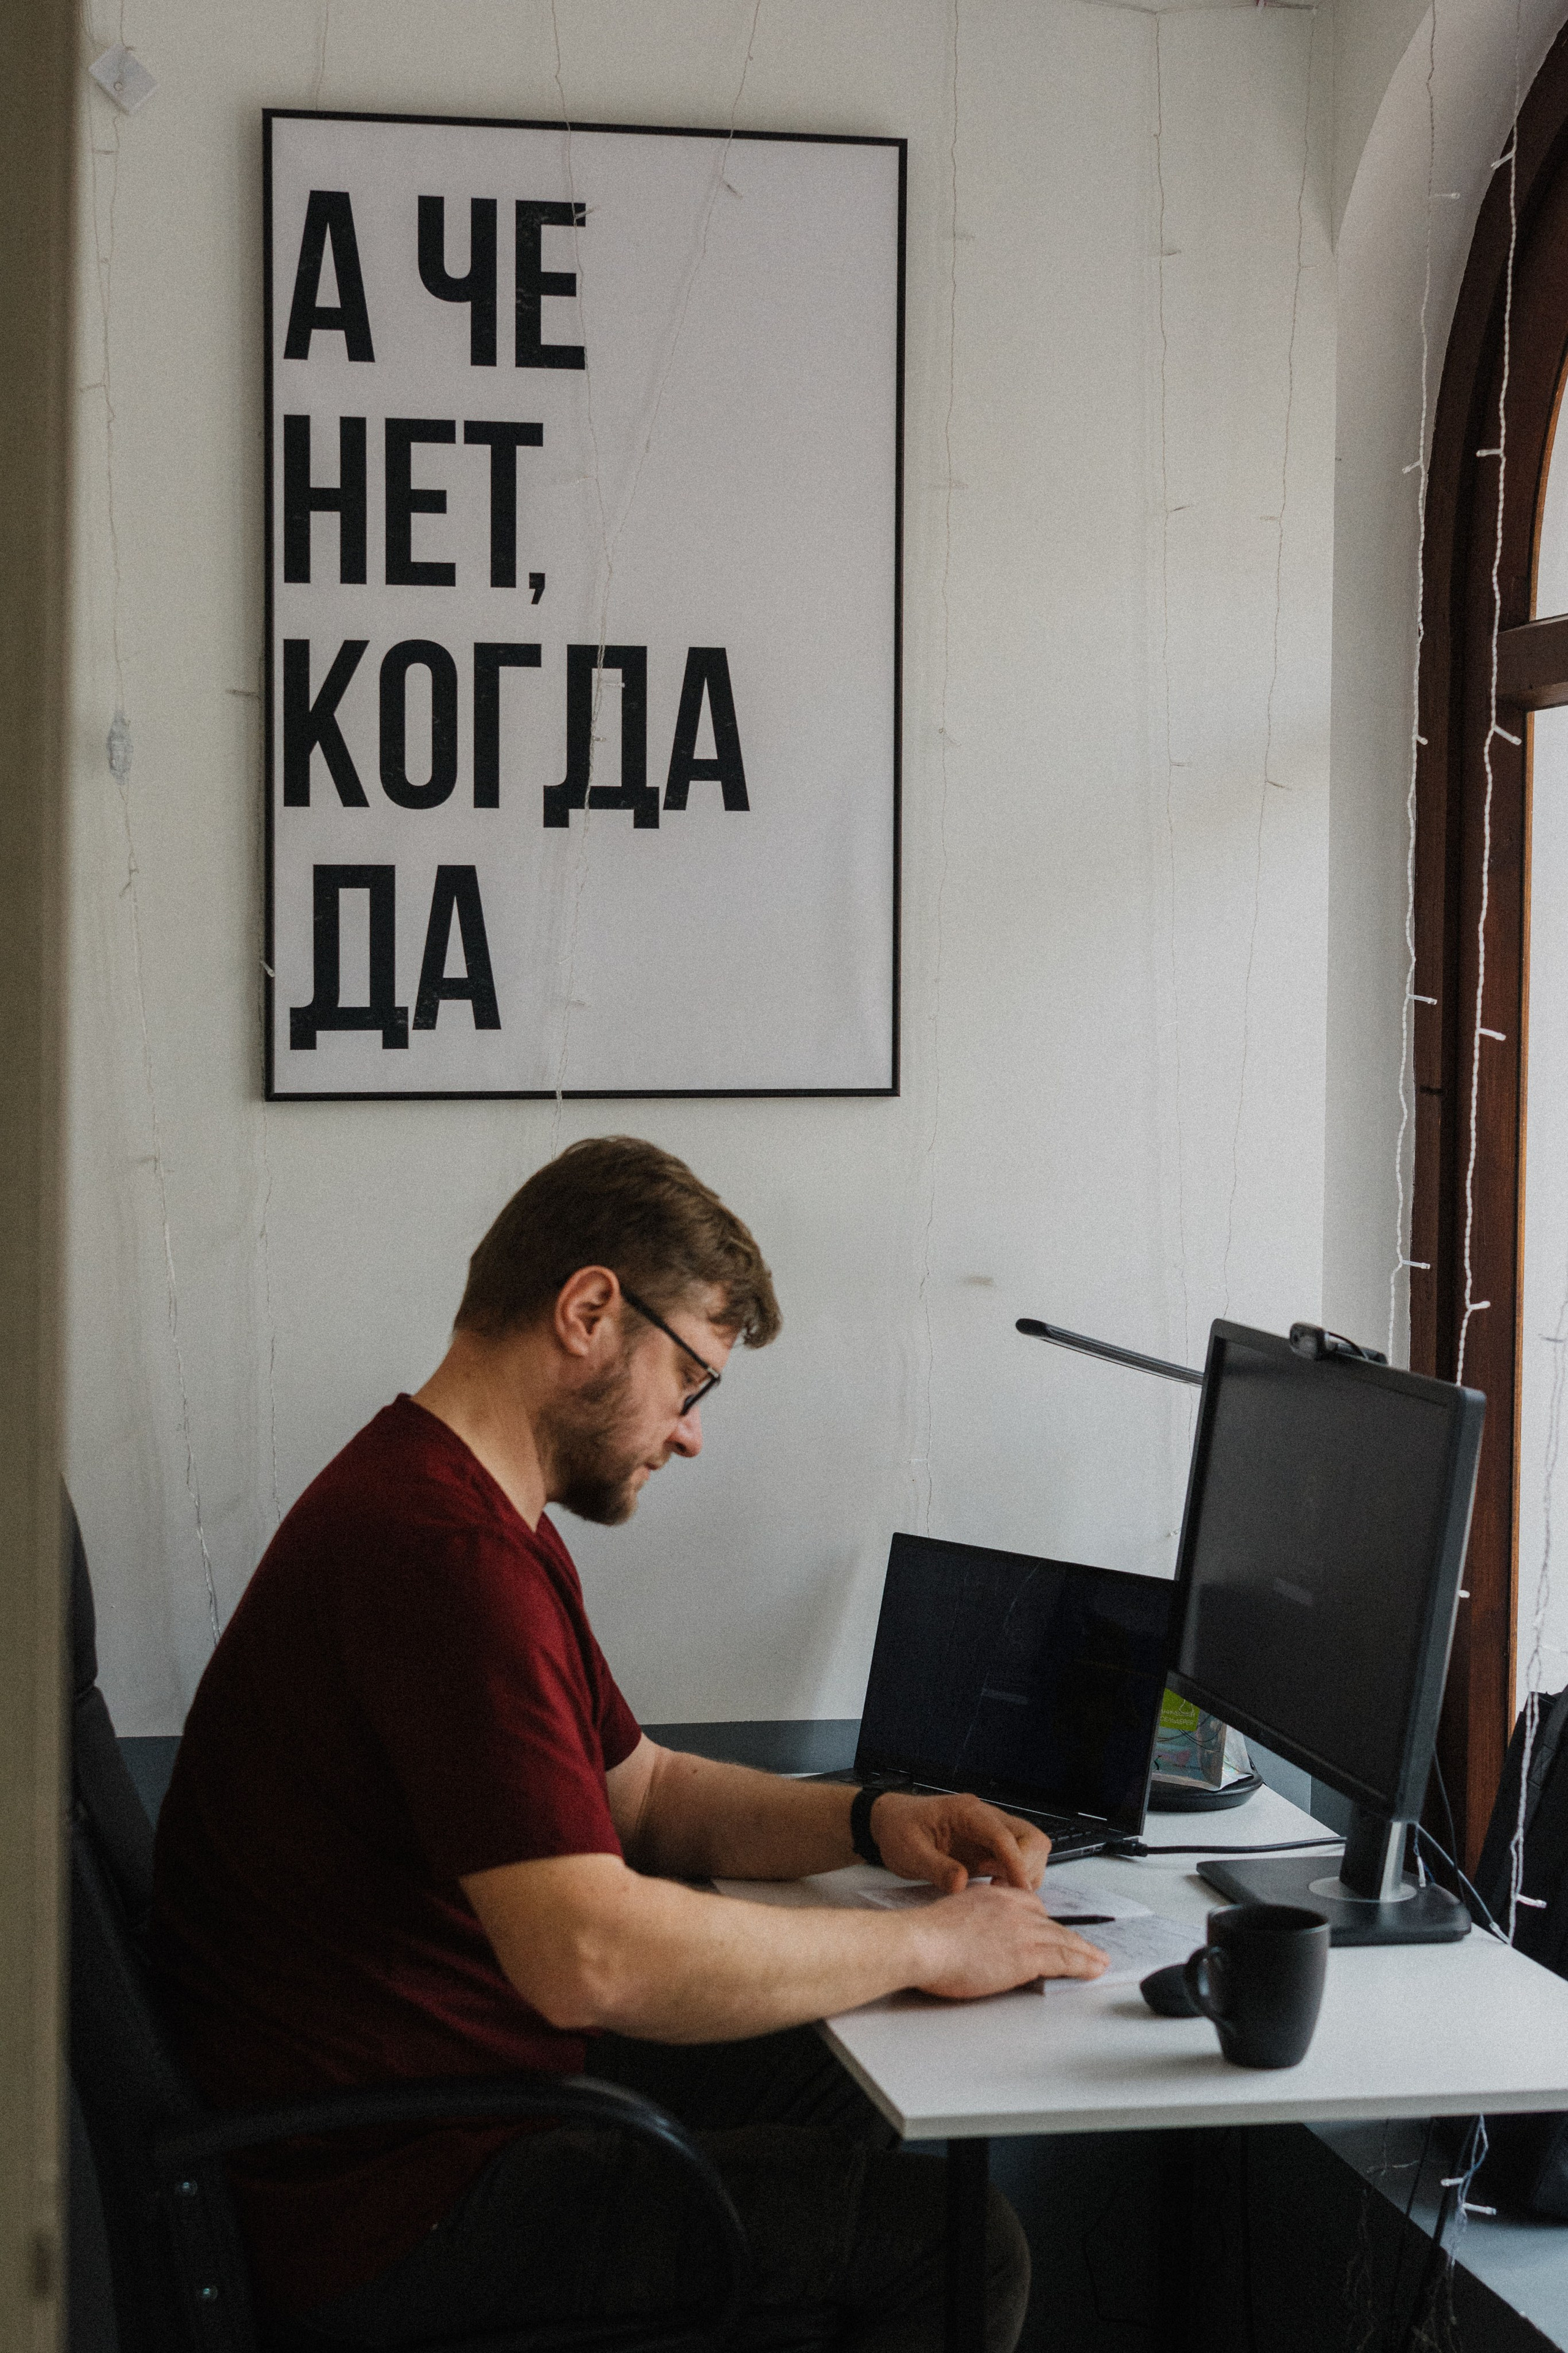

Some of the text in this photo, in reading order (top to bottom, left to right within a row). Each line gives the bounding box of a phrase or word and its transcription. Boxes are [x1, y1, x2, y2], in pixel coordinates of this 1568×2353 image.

[284, 190, 586, 370] А ЧЕ
[284, 415, 546, 605] НЕТ,
[284, 639, 750, 829] КОГДА
[290, 864, 501, 1050] ДА
